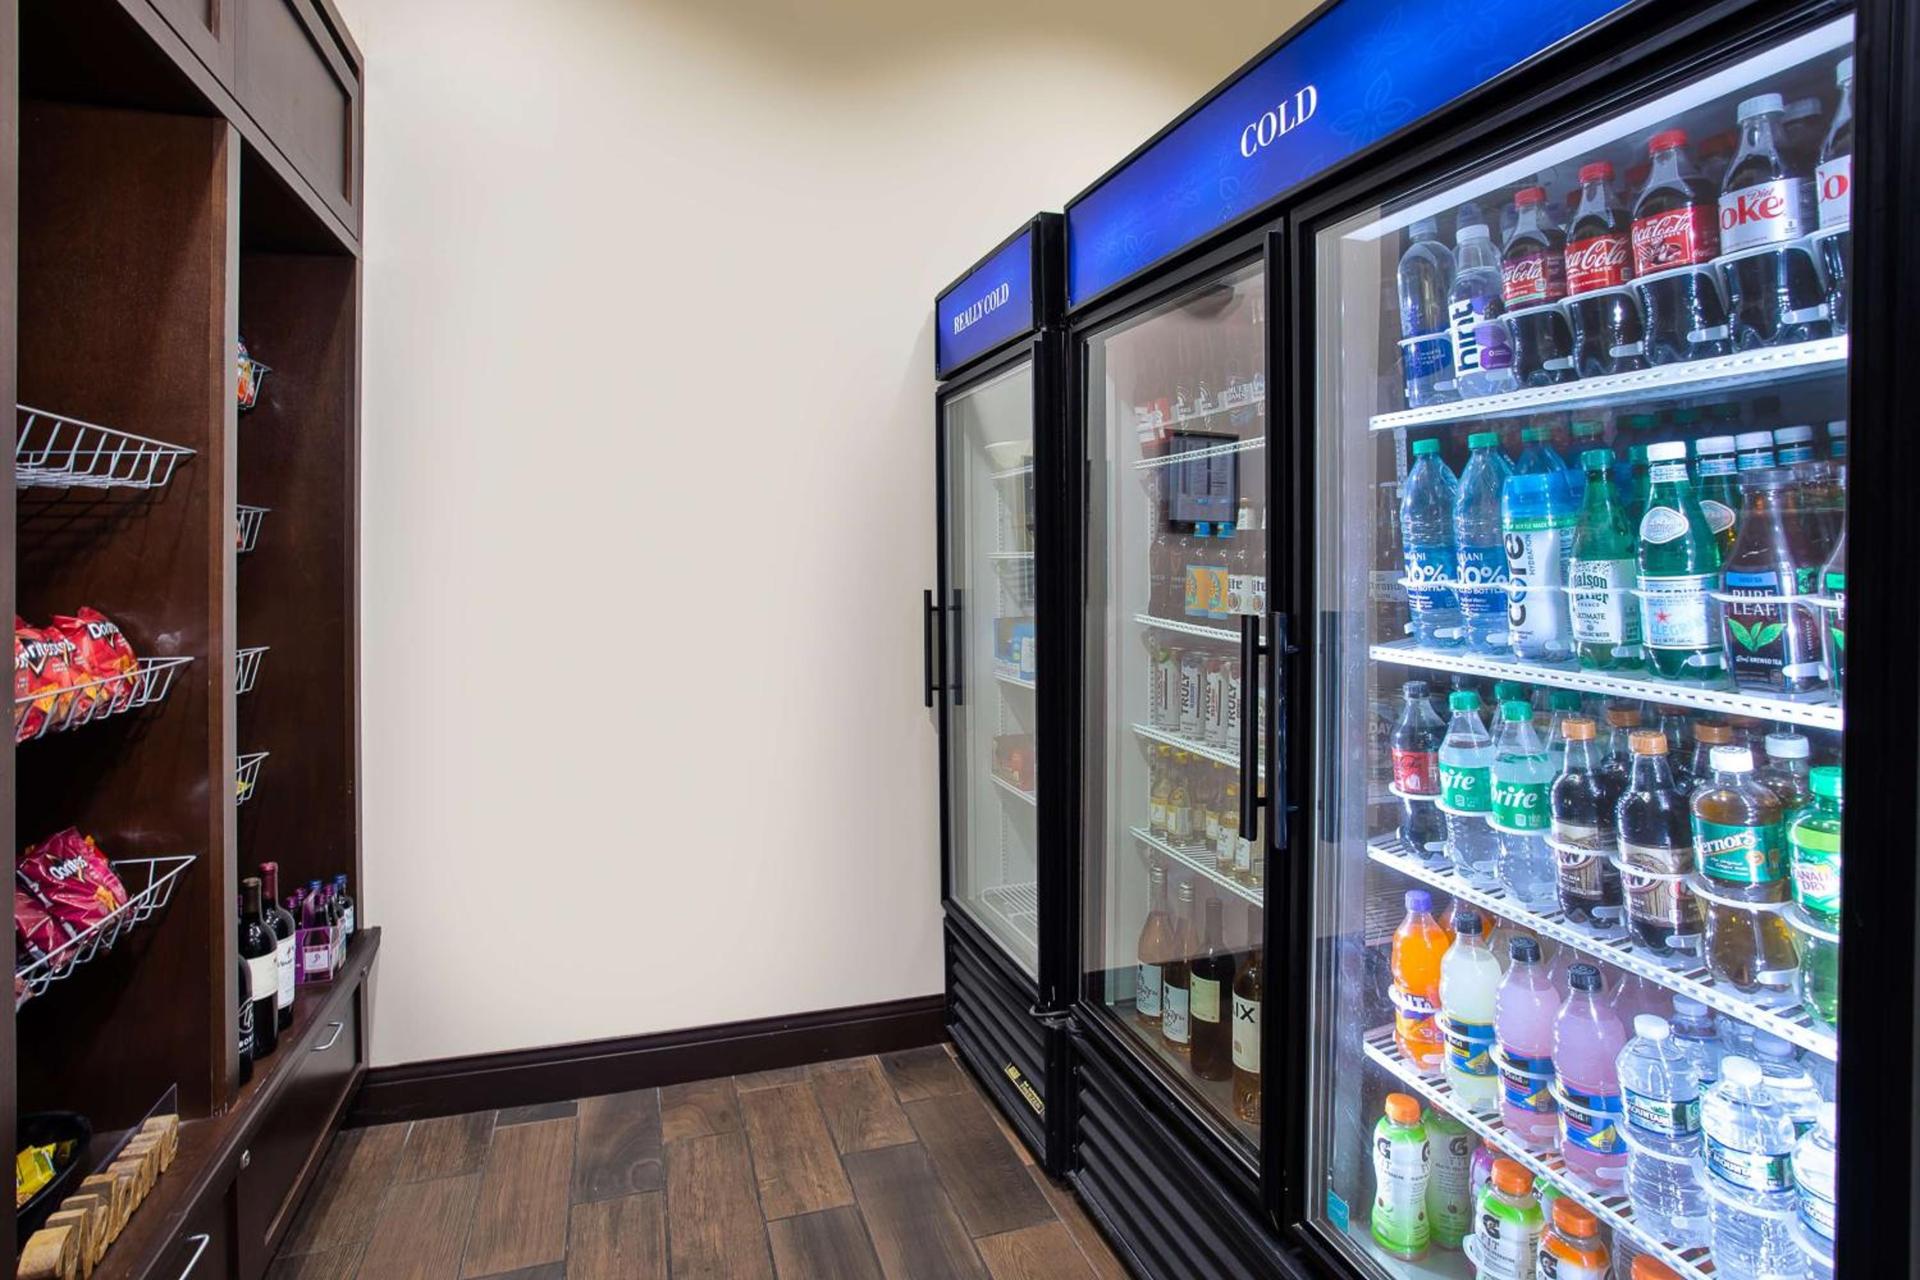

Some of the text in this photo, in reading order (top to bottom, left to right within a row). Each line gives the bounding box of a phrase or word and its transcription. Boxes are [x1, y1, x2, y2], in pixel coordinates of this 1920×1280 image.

[1240, 84, 1318, 158] COLD
[1721, 195, 1784, 230] oke
[953, 283, 1009, 336] REALLY COLD
[1452, 299, 1479, 372] hint
[1181, 673, 1190, 714] TRULY
[1228, 684, 1237, 728] TRULY
